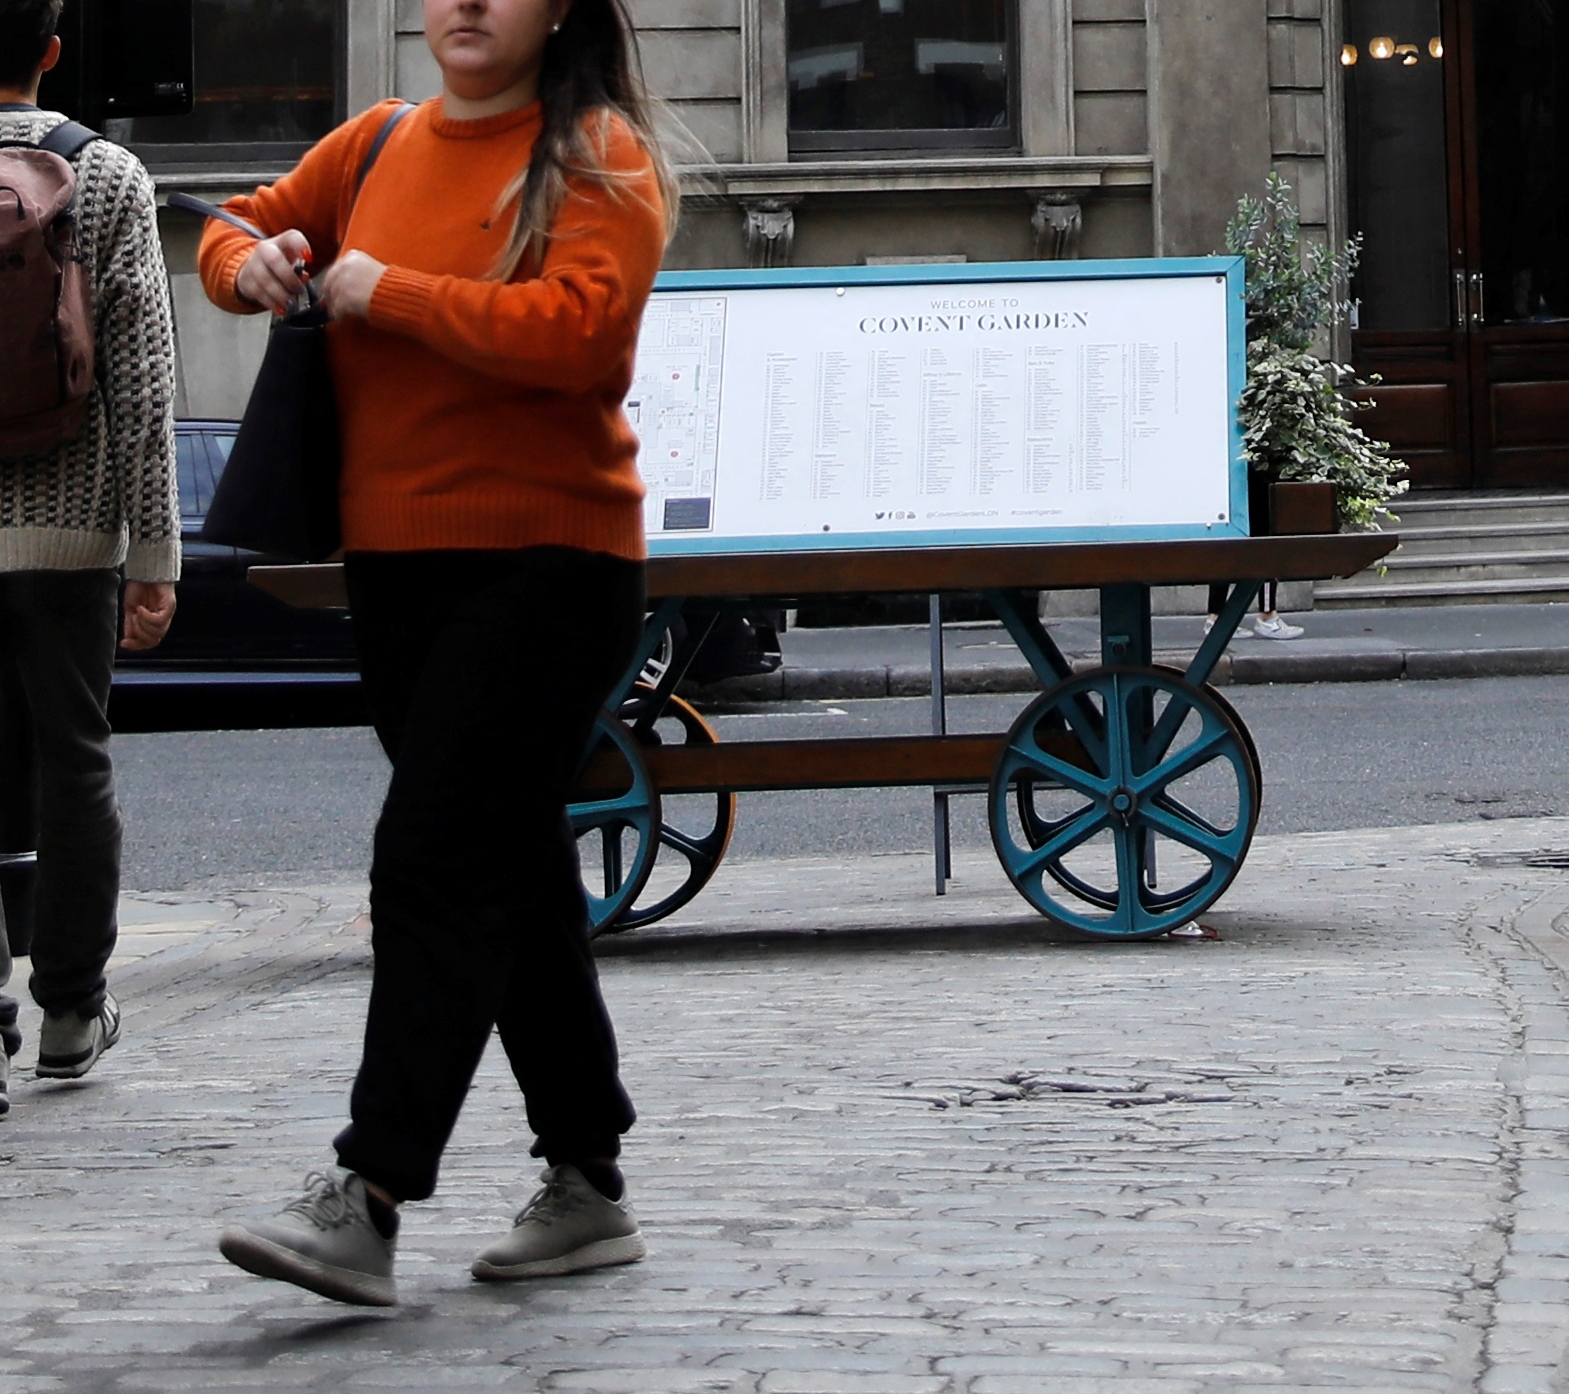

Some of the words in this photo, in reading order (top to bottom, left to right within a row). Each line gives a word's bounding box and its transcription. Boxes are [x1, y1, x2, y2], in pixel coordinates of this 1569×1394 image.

[930, 299, 996, 310] WELCOME
[1001, 298, 1019, 308] TO
[859, 315, 971, 334] COVENT
[977, 311, 1089, 331] GARDEN
